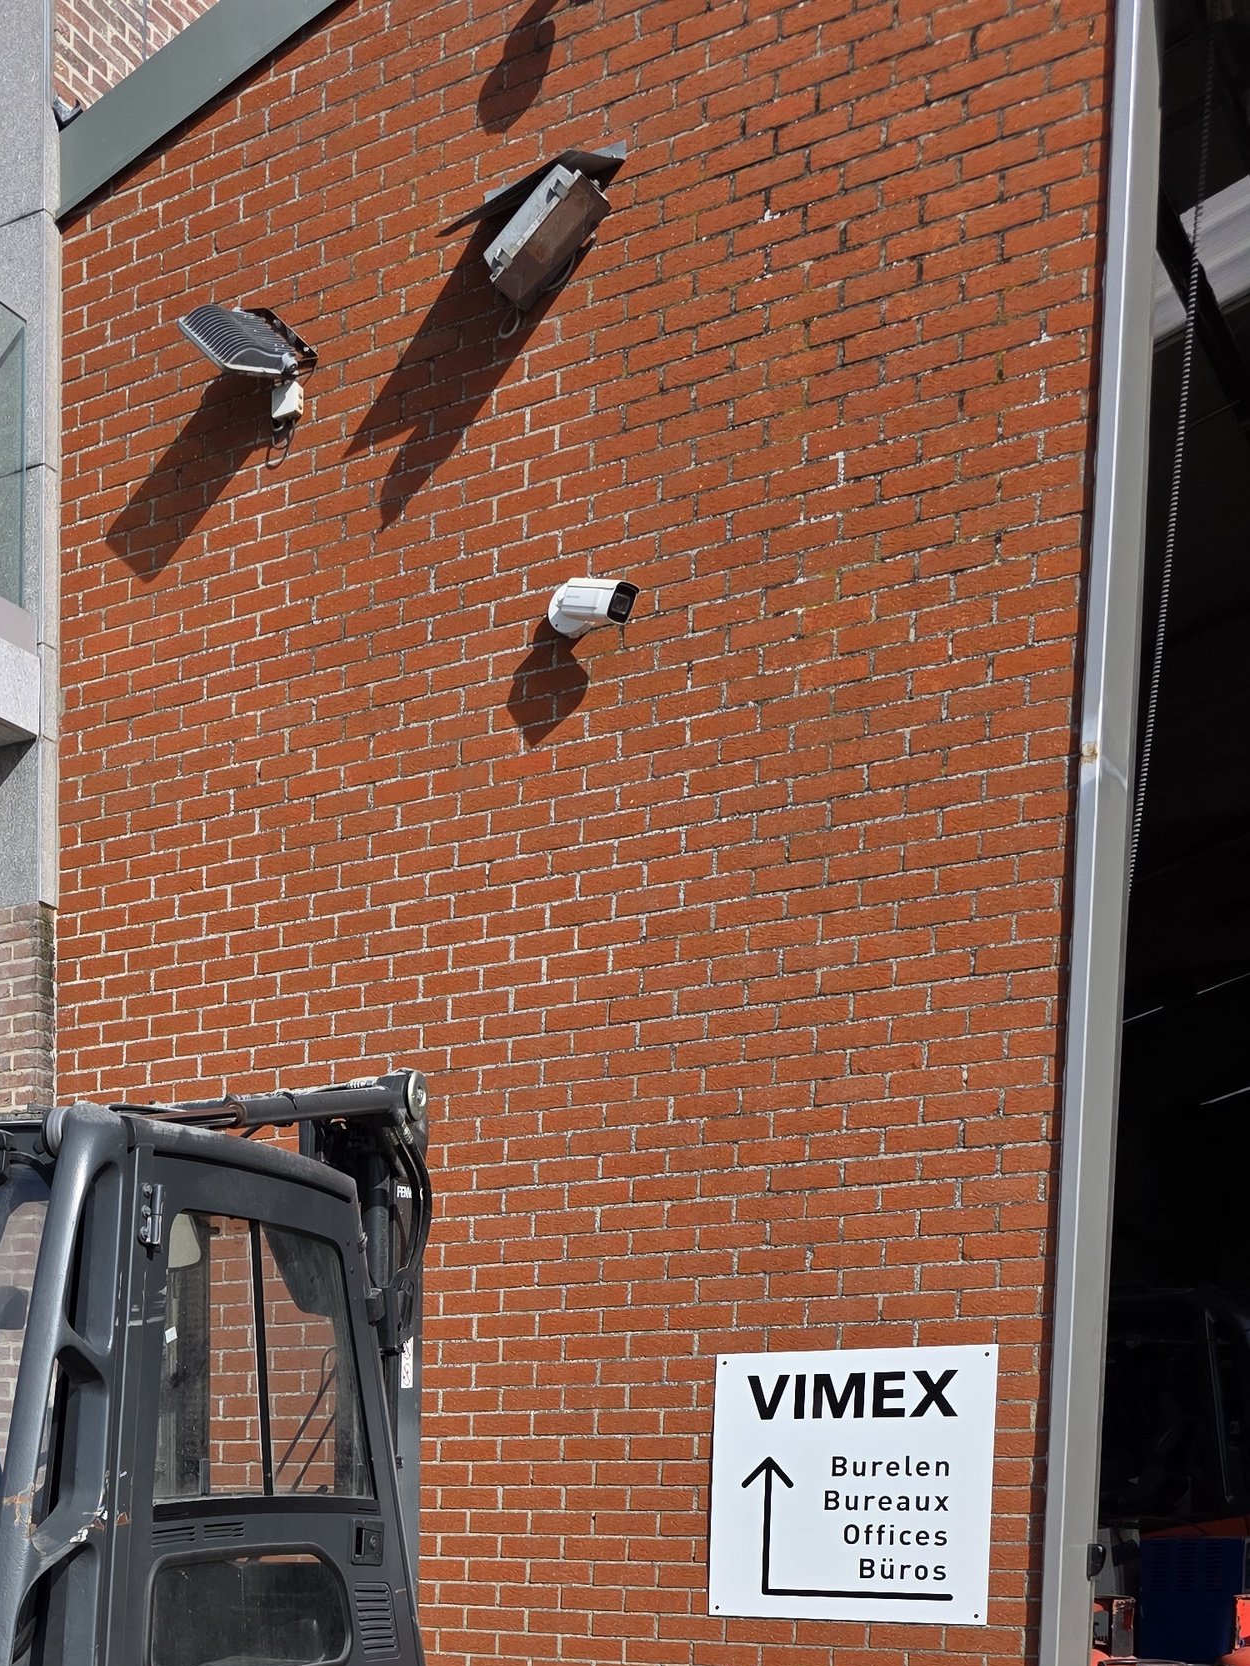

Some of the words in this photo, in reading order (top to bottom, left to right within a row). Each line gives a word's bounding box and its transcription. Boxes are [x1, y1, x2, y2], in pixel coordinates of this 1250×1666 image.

[747, 1369, 959, 1420] VIMEX
[831, 1455, 950, 1477] Burelen
[823, 1490, 950, 1512] Bureaux
[843, 1523, 948, 1546] Offices
[859, 1557, 947, 1581] Büros
